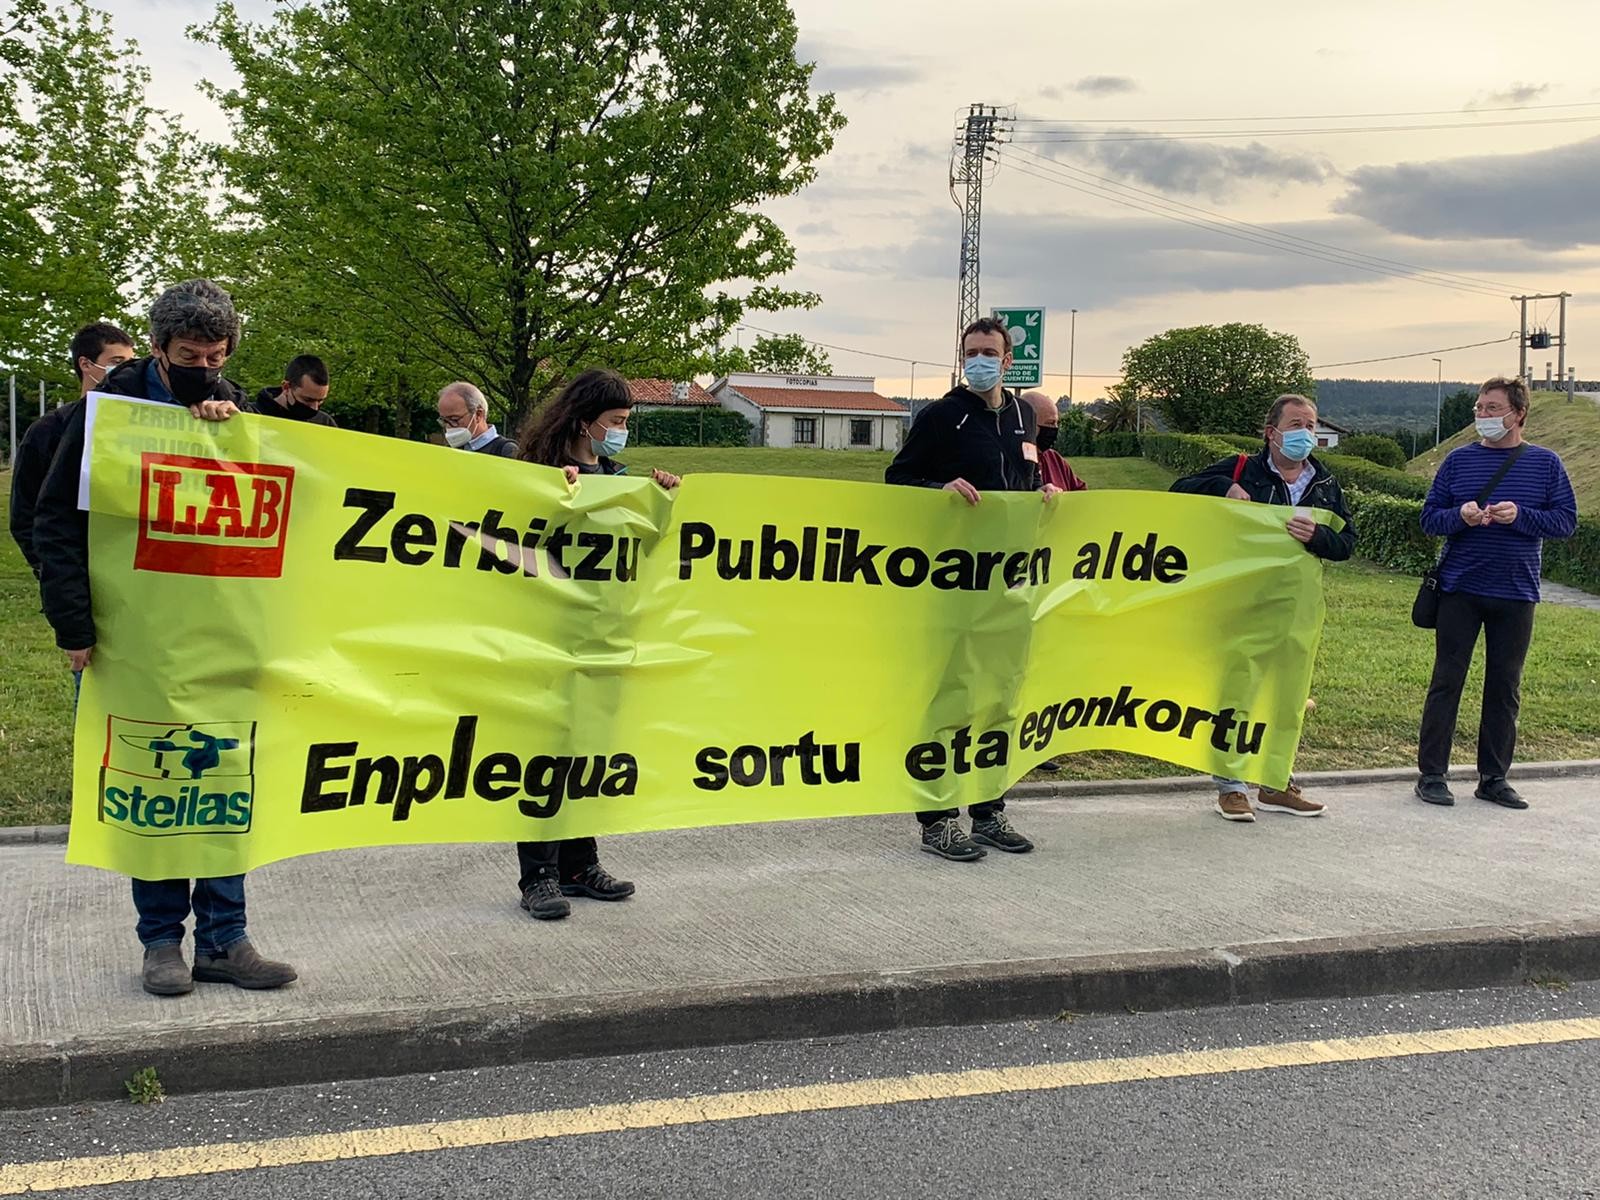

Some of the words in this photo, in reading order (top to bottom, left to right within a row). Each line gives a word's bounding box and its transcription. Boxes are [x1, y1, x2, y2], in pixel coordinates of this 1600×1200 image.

[150, 470, 283, 539] LAB
[334, 488, 642, 583] Zerbitzu
[678, 521, 1051, 591] Publikoaren
[1072, 530, 1189, 584] alde
[300, 715, 639, 822] Enplegua
[692, 731, 861, 792] sortu
[904, 726, 1009, 782] eta
[1019, 685, 1267, 755] egonkortu
[104, 785, 250, 829] steilas
